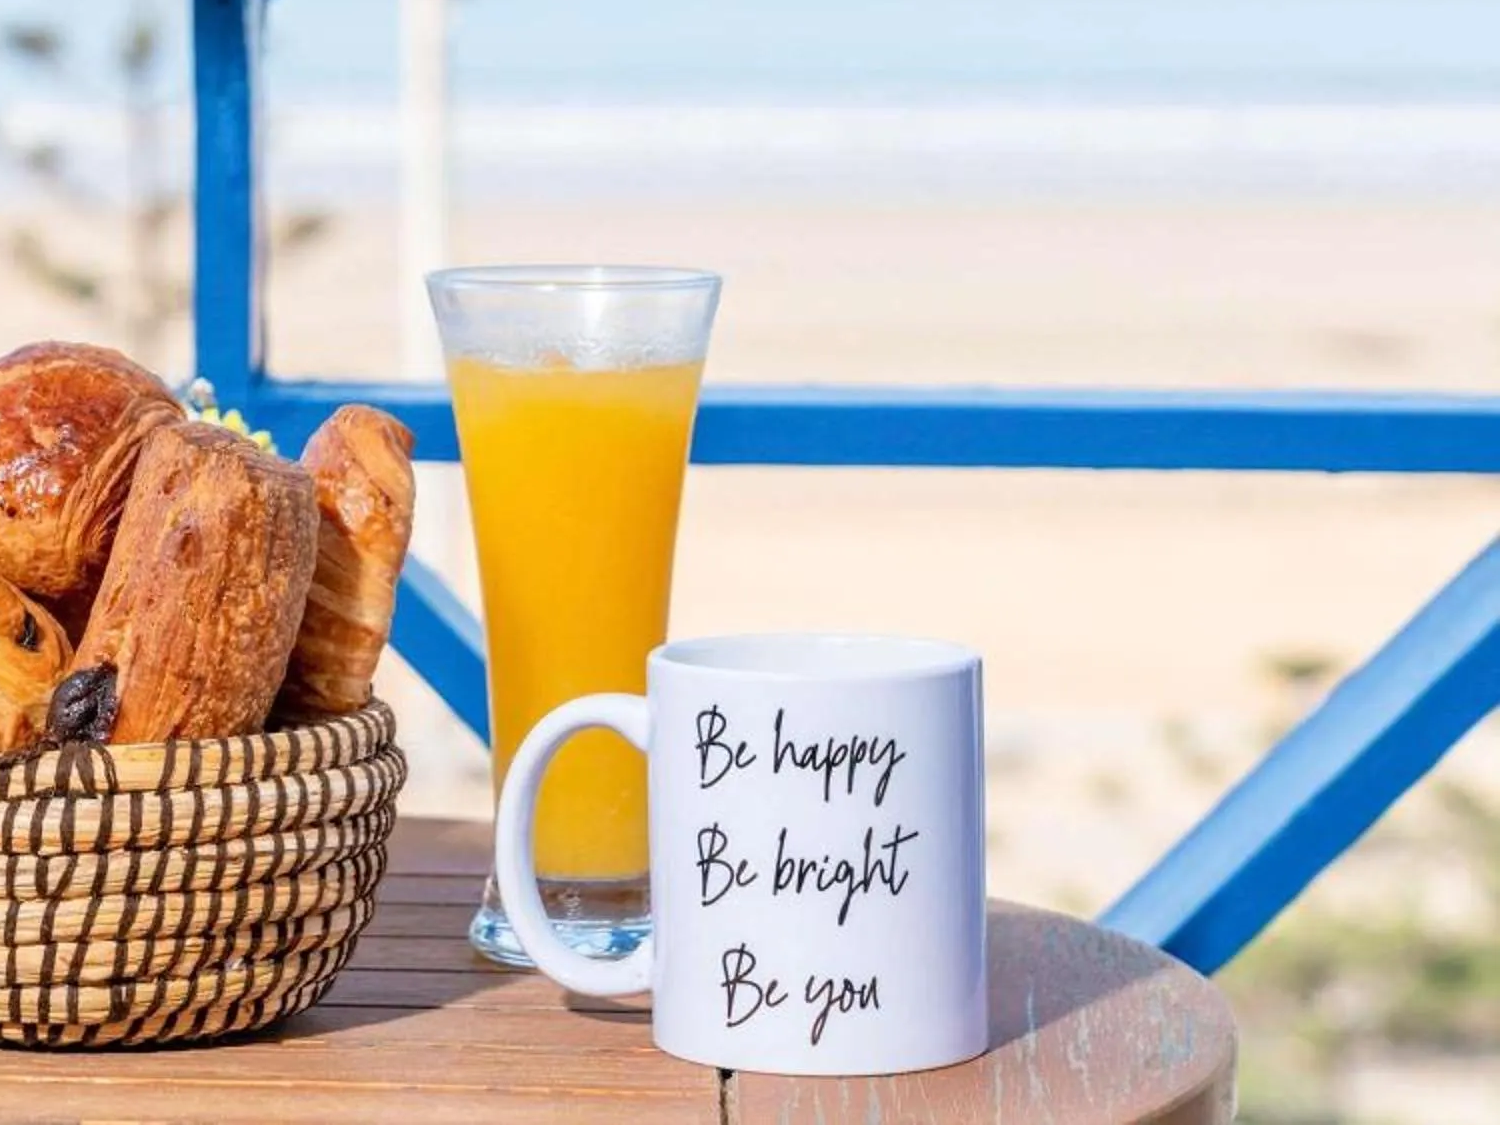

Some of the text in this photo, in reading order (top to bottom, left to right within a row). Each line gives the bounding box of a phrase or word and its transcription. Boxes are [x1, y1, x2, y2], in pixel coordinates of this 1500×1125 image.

[695, 704, 906, 807] Be happy
[696, 822, 919, 926] Be bright
[720, 943, 880, 1046] Be you
